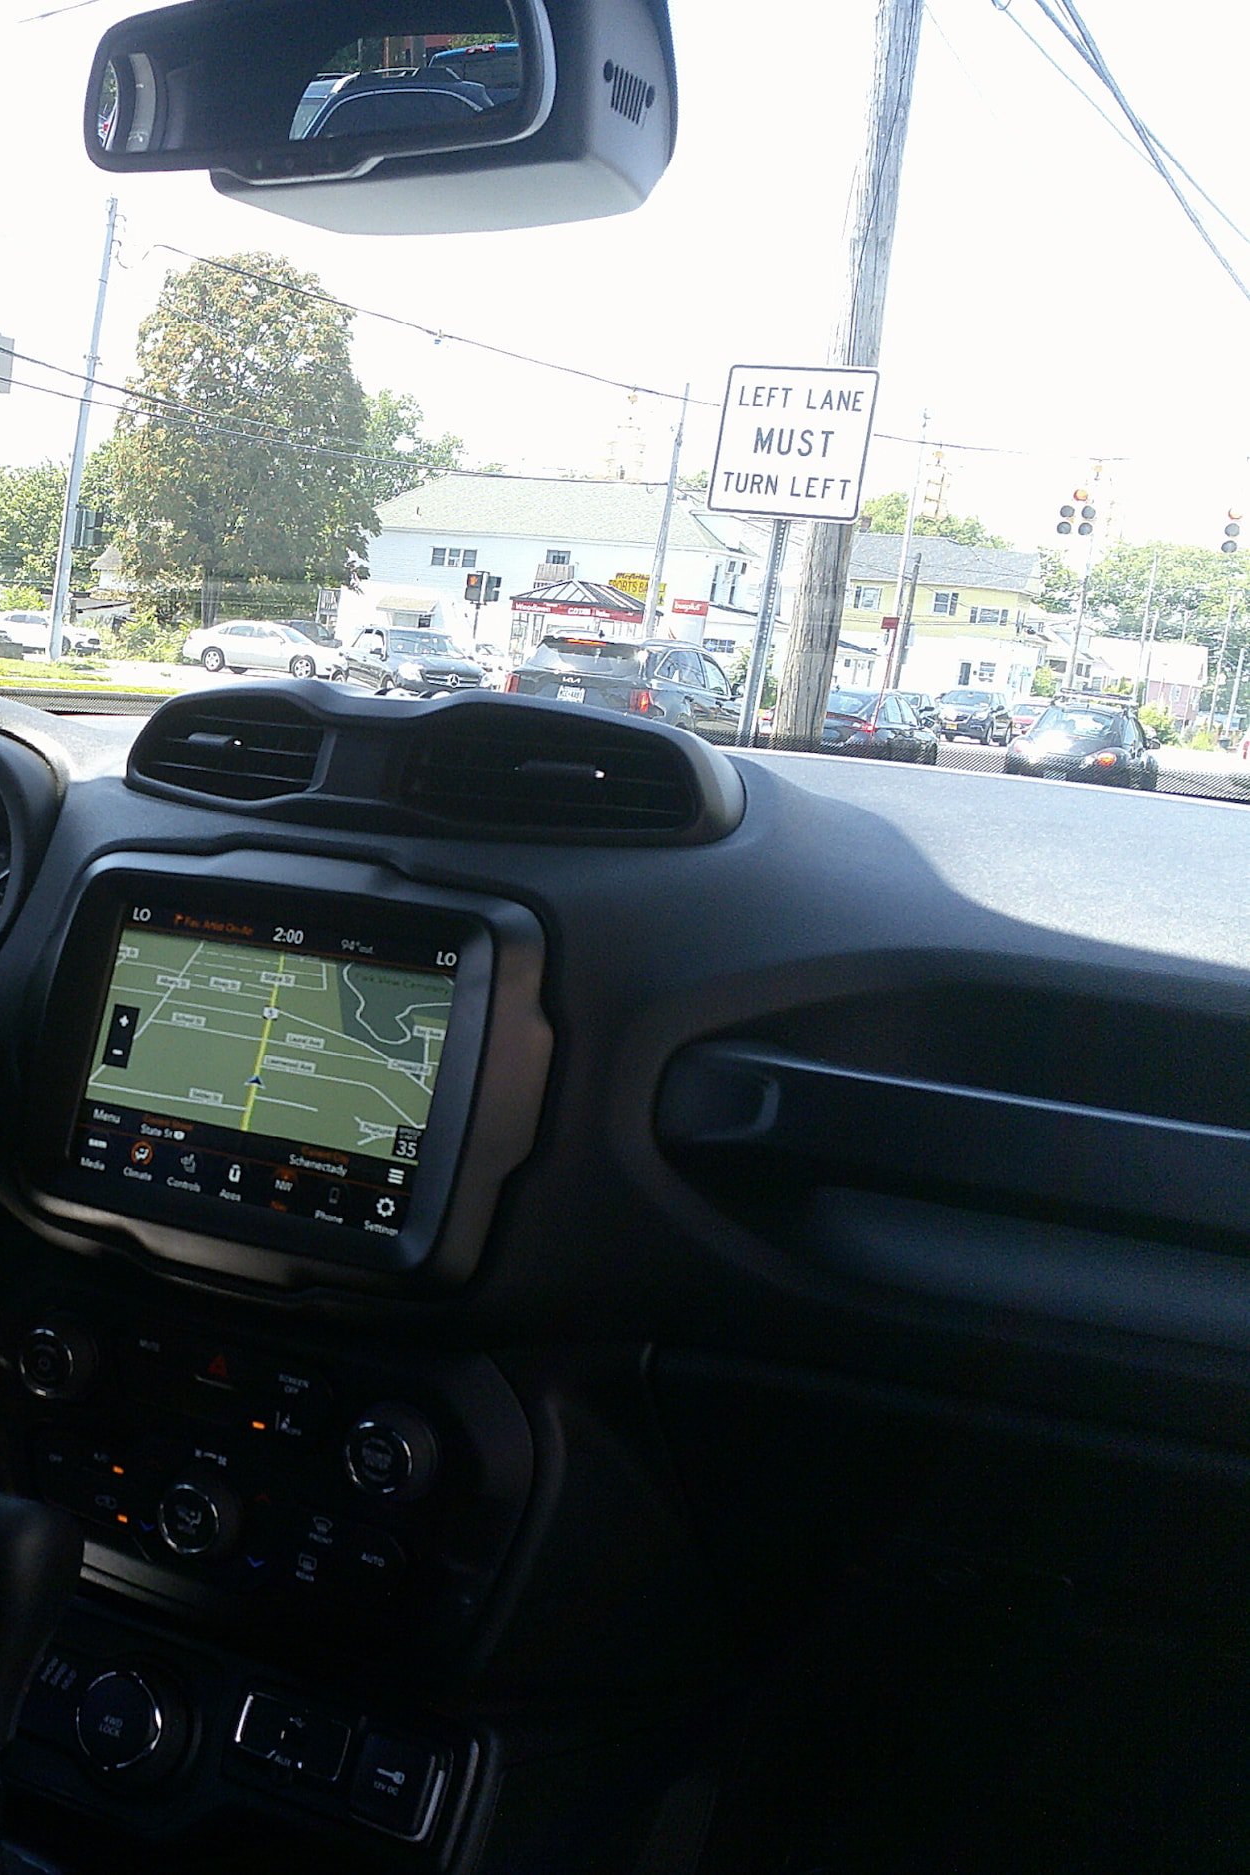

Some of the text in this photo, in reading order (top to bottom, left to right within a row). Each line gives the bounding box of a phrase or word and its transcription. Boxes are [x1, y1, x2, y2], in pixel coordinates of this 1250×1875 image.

[739, 385, 864, 412] LEFT LANE
[753, 427, 834, 457] MUST
[723, 472, 851, 500] TURN LEFT
[132, 906, 152, 921] LO
[272, 926, 304, 945] 2:00
[436, 951, 457, 967] LO
[93, 1108, 121, 1125] Menu
[139, 1123, 173, 1139] State St
[395, 1140, 418, 1158] 35
[80, 1156, 106, 1172] Media
[288, 1153, 348, 1178] Schenectady
[123, 1166, 153, 1182] Climate
[166, 1176, 201, 1193] Controls
[314, 1209, 344, 1225] Phone
[364, 1219, 399, 1237] Settings
[360, 1551, 386, 1567] AUTO
